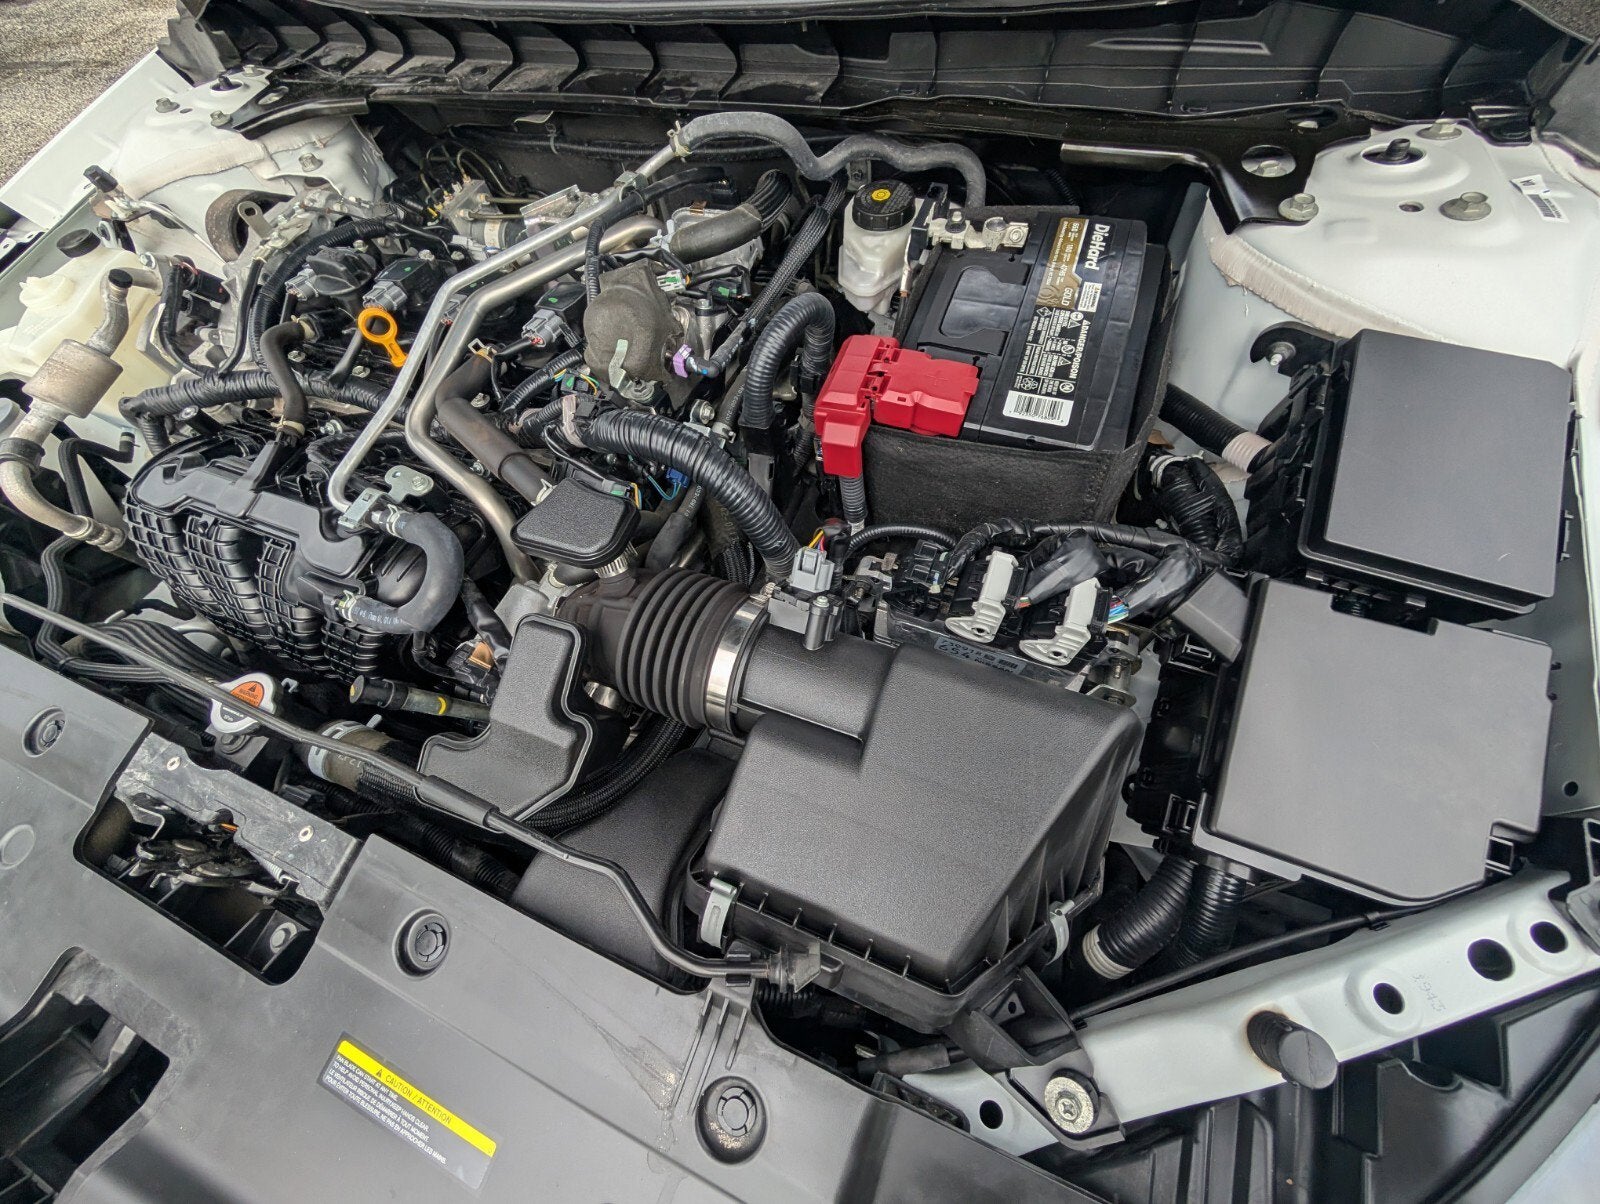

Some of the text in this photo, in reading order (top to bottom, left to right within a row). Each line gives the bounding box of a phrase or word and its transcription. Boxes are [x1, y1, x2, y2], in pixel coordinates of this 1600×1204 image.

[1084, 223, 1110, 271] DieHard
[1061, 287, 1073, 306] GOLD
[1069, 324, 1090, 379] DANGER/POISON
[338, 1064, 349, 1075] HELP
[354, 1067, 365, 1077] CAN
[384, 1074, 413, 1097] CAUTION
[416, 1096, 452, 1124] ATTENTION
